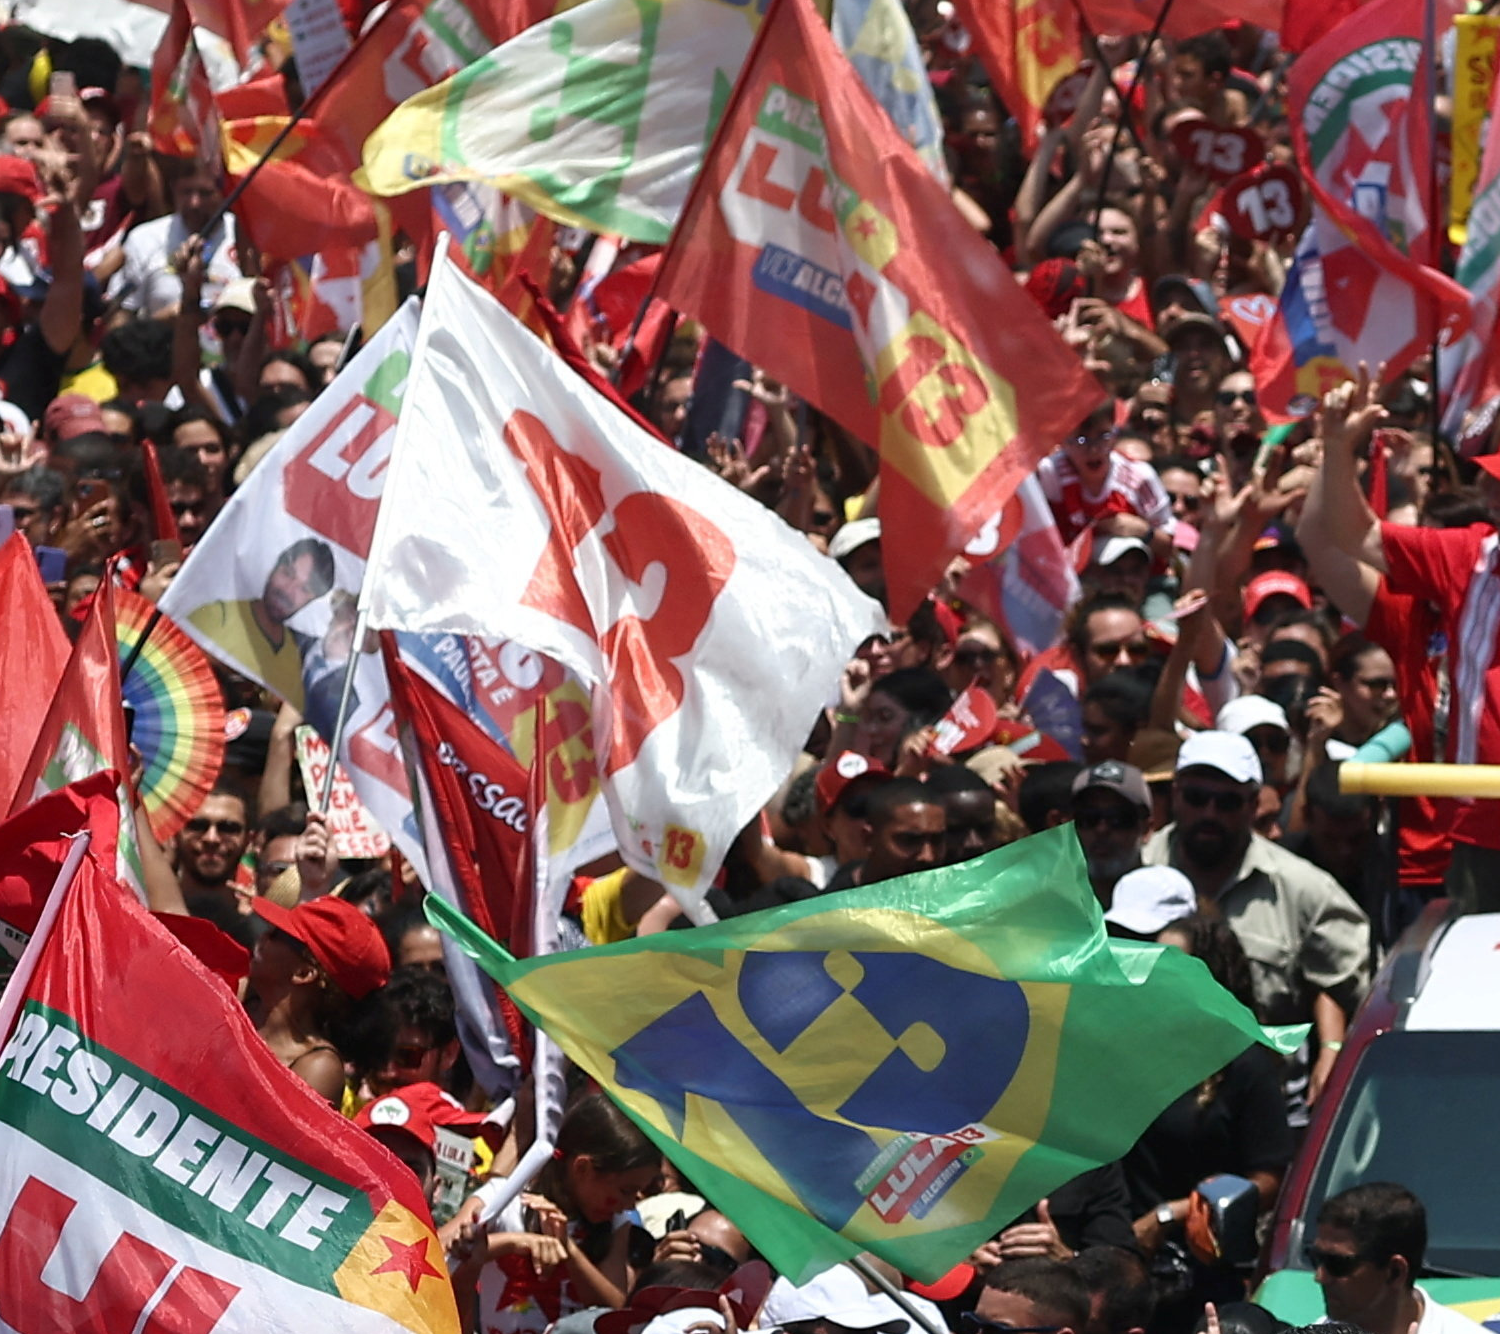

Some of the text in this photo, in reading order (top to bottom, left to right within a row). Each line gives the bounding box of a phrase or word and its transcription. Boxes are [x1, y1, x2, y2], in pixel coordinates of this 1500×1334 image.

[1237, 177, 1296, 236] 13
[665, 829, 696, 870] 13
[0, 1003, 350, 1253] PRESIDENTE
[867, 1139, 954, 1220] LULA
